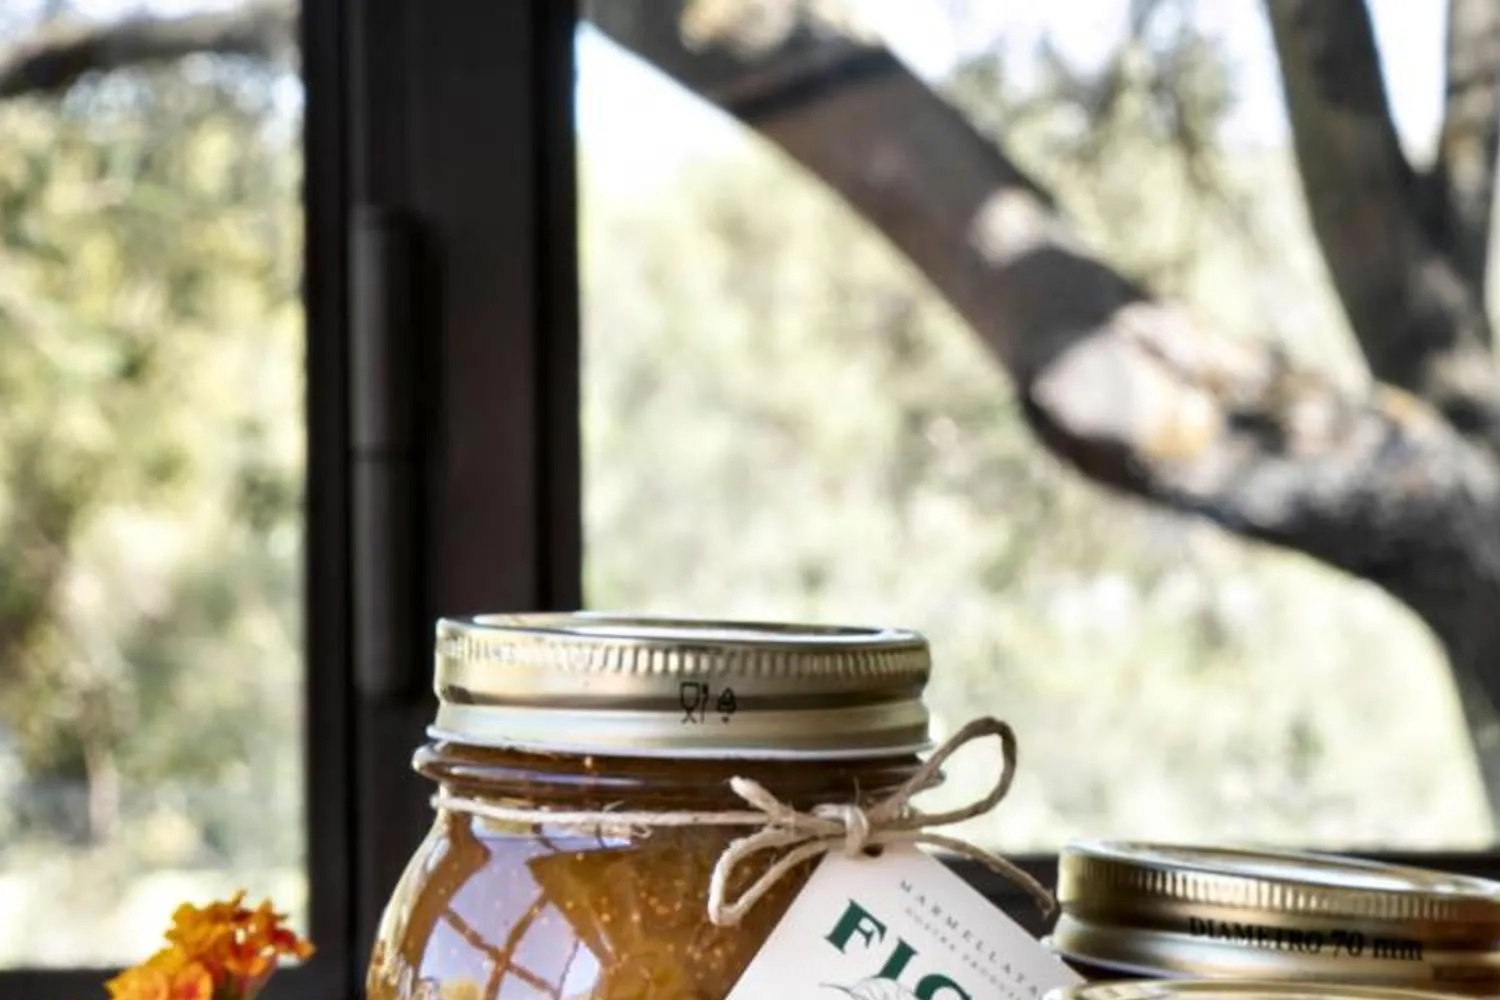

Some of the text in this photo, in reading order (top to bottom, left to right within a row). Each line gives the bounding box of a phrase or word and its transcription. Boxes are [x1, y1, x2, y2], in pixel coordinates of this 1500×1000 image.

[1189, 917, 1423, 961] DIAMETRO 70 mm
